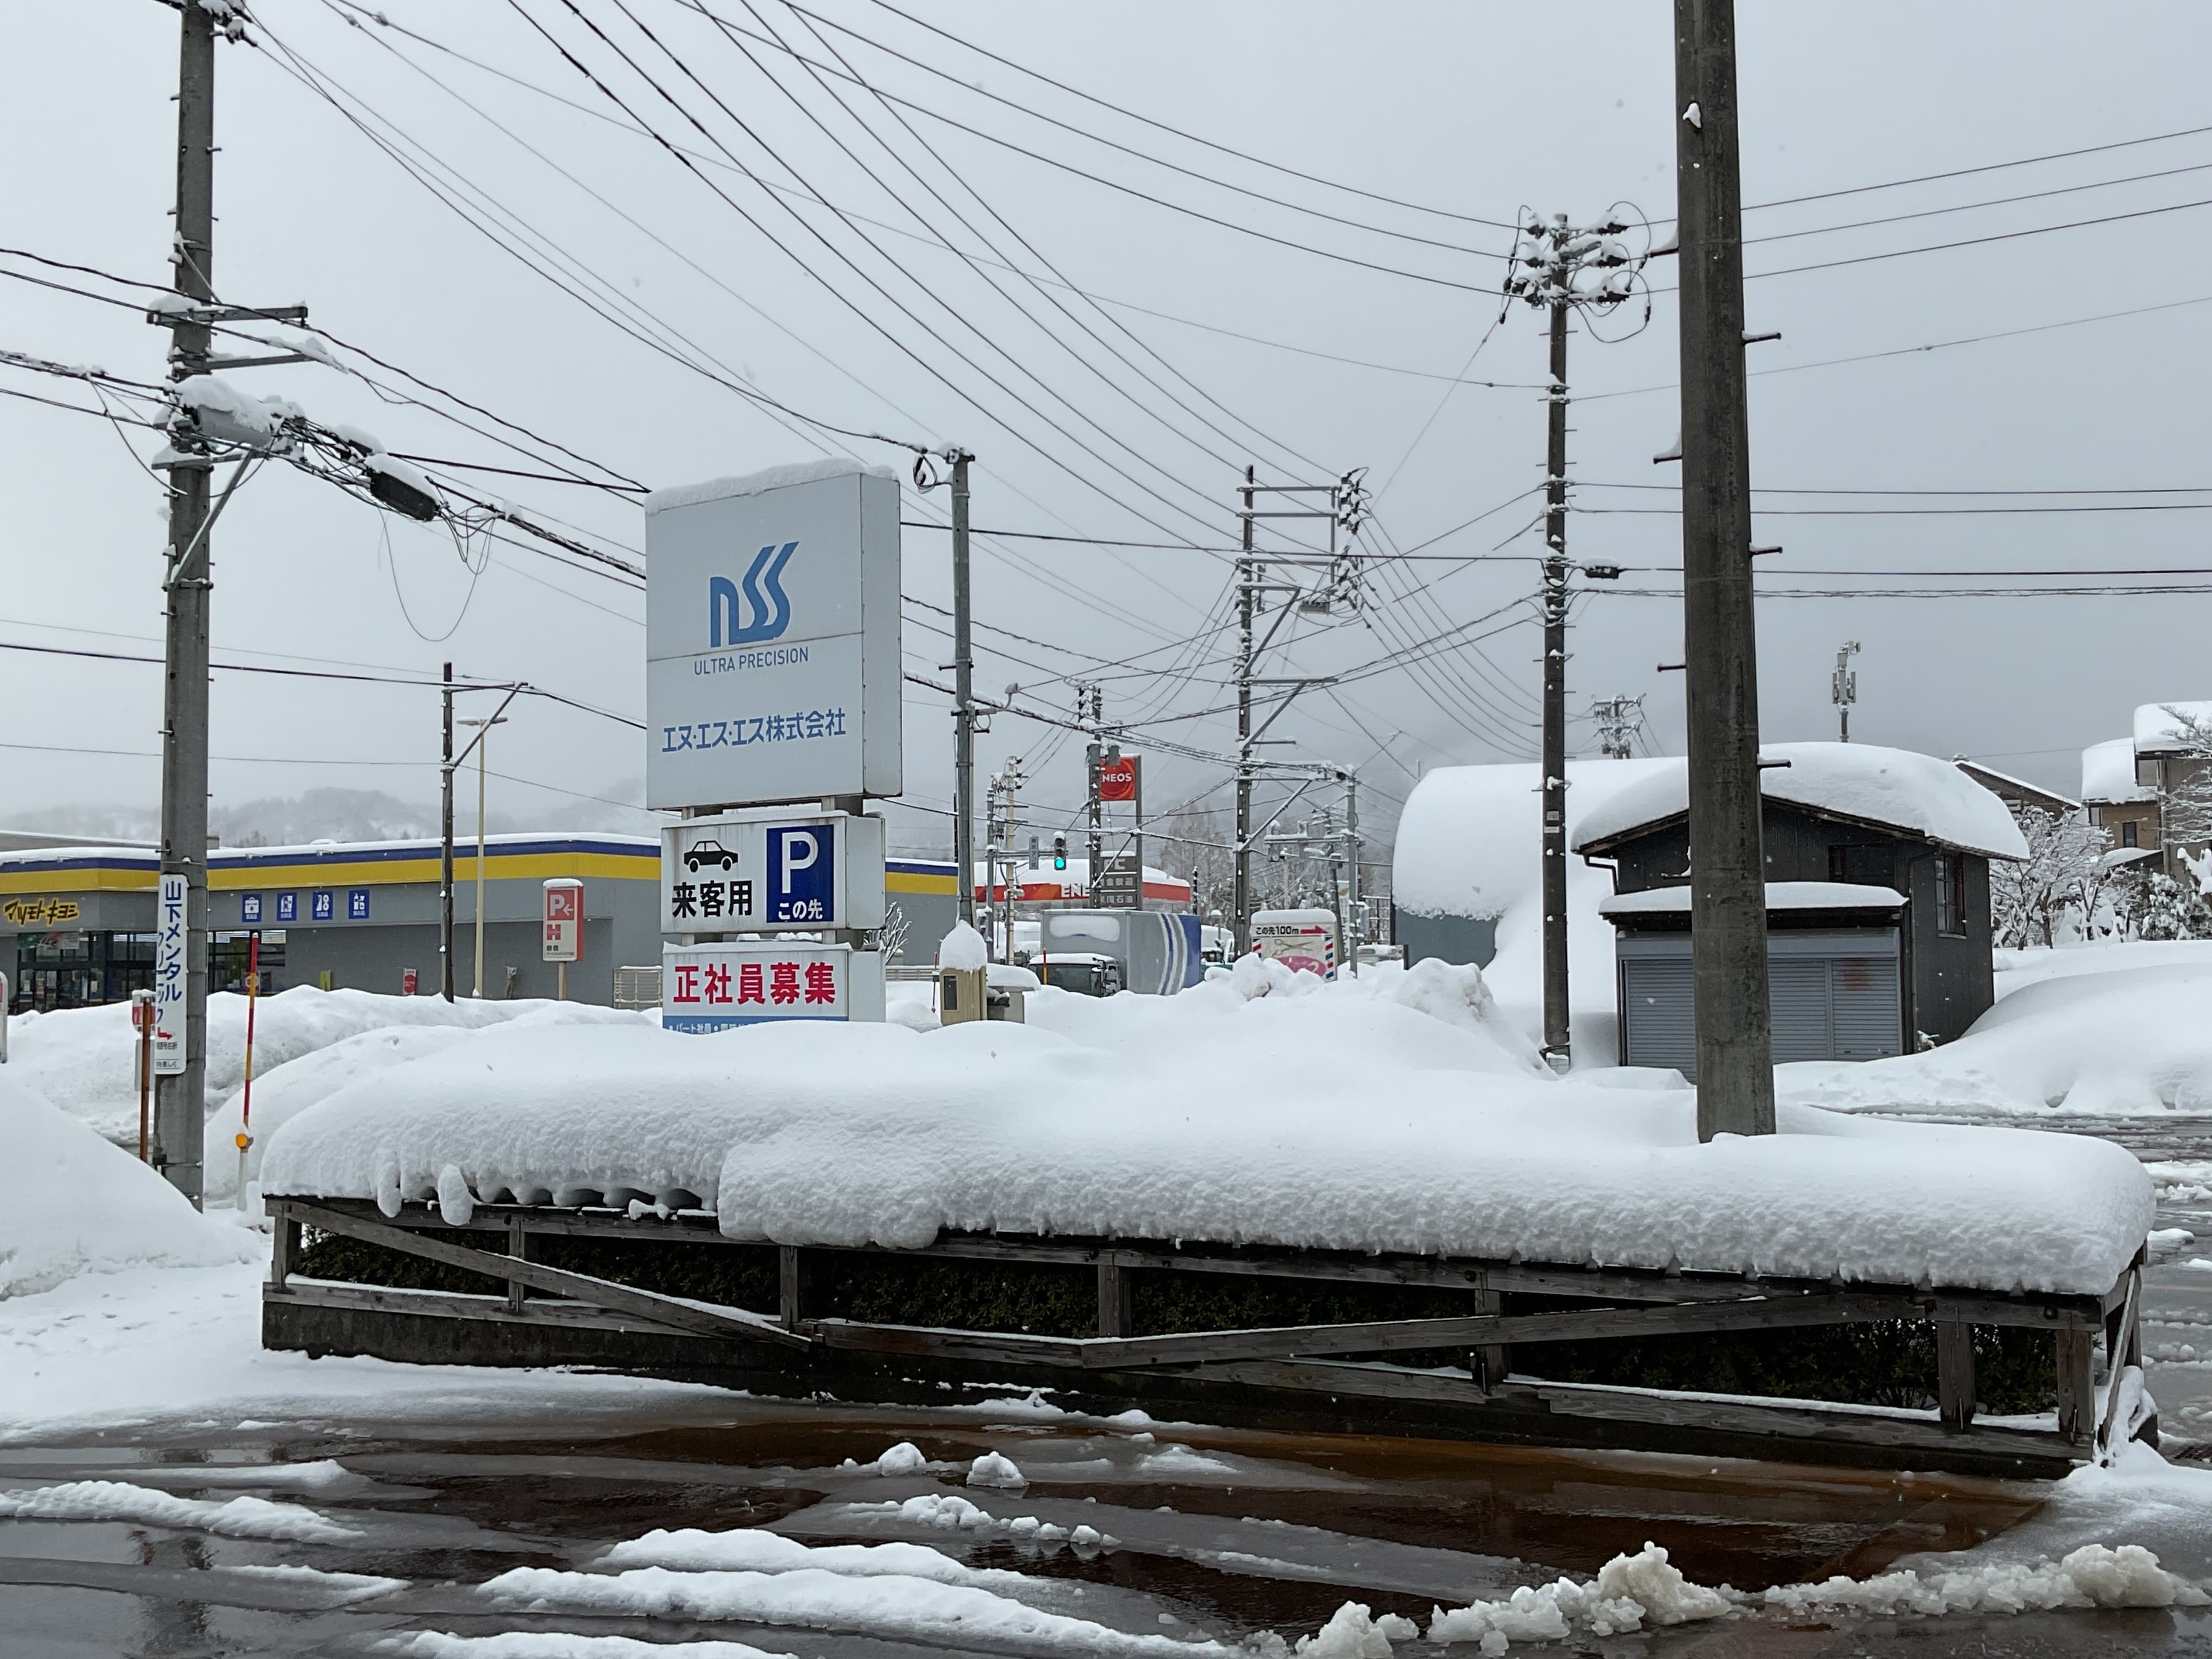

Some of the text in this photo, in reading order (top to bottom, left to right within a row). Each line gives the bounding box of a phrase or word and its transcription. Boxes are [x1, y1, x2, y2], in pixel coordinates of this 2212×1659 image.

[694, 646, 809, 676] ULTRA PRECISION
[1100, 773, 1132, 782] NEOS
[781, 831, 819, 894] P
[672, 880, 752, 918] 来客用
[1061, 882, 1090, 898] ENE
[3, 898, 79, 926] マツモトキヨシ
[549, 894, 565, 916] P
[778, 899, 823, 920] この先
[165, 881, 183, 1002] 山下メンタル
[673, 961, 836, 1005] 正社員募集
